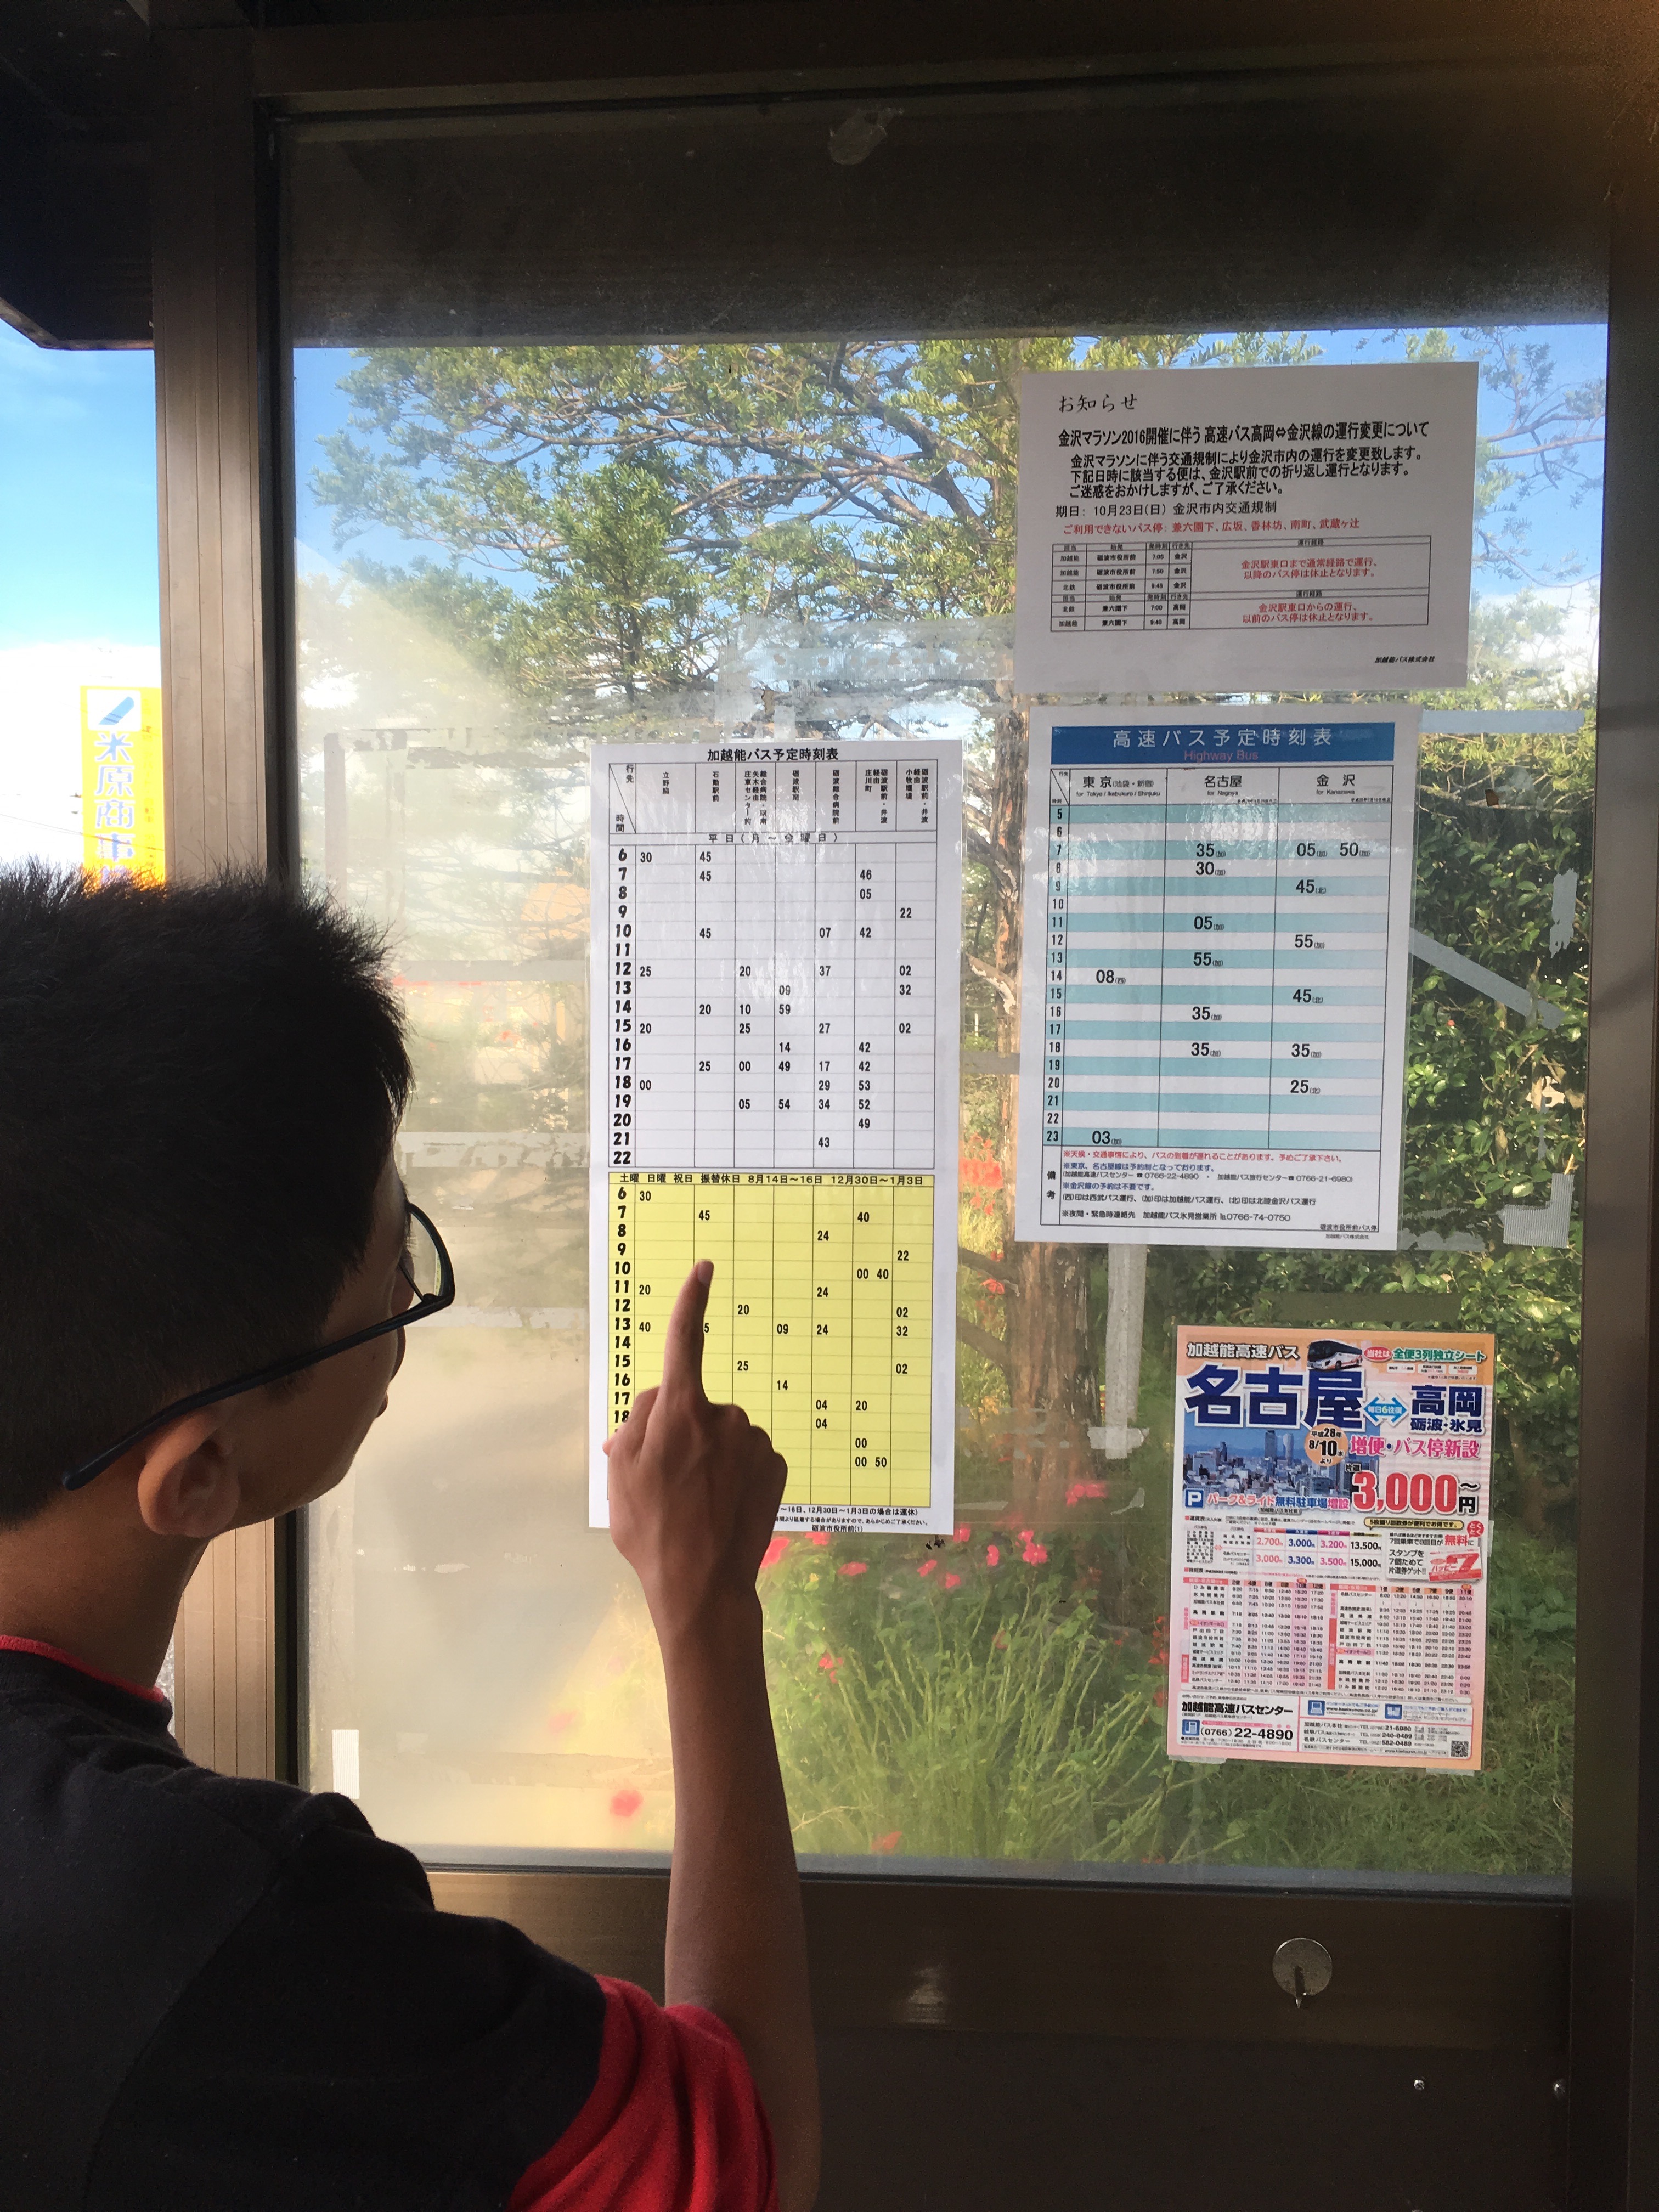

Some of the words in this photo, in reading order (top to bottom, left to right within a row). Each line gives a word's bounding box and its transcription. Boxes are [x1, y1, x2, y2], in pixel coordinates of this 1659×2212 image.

[1059, 393, 1137, 413] お知らせ
[1071, 445, 1421, 469] 金沢マラソンに伴う交通規制により金沢市内の運行を変更致します。
[1070, 461, 1409, 483] 下記日時に該当する便は、金沢駅前での折り返し運行となります。
[1070, 479, 1283, 499] ご迷惑をおかけしますが、ご了承ください。
[1172, 500, 1277, 515] 金沢市内交通規制
[1241, 557, 1377, 569] 金沢駅東口まで通常経路で運行、
[1243, 567, 1375, 579] 以降のバス停は休止となります。
[1259, 601, 1357, 613] 金沢駅東口からの運行、
[1242, 611, 1373, 623] 以前のバス停は休止となります。
[1113, 728, 1332, 748] 高速バス予定時刻表
[707, 747, 838, 762] 加越能バス予定時刻表
[1184, 750, 1233, 762] Highway
[1237, 751, 1259, 760] Bus
[625, 765, 634, 783] 行先
[1204, 775, 1242, 788] 名古屋
[616, 814, 625, 833] 時間
[618, 848, 627, 861] 6
[640, 851, 652, 863] 30
[699, 851, 712, 862] 45
[1057, 844, 1062, 856] 7
[618, 867, 627, 881] 7
[699, 870, 712, 882] 45
[860, 869, 872, 881] 46
[1056, 862, 1061, 874] 8
[1052, 952, 1063, 963] 13
[616, 962, 631, 975] 12
[640, 966, 651, 977] 25
[739, 966, 751, 977] 20
[819, 965, 831, 977] 37
[899, 965, 911, 976] 02
[1051, 970, 1062, 981] 14
[1049, 1041, 1060, 1053] 18
[616, 1057, 631, 1070] 17
[699, 1060, 711, 1071] 25
[738, 1060, 751, 1072] 00
[778, 1060, 791, 1072] 49
[819, 1060, 831, 1072] 17
[858, 1060, 871, 1072] 42
[1047, 1130, 1058, 1142] 23
[620, 1172, 640, 1183] 土曜
[647, 1173, 667, 1183] 日曜
[673, 1173, 692, 1183] 祝日
[701, 1173, 740, 1184] 振替休日
[1047, 1170, 1056, 1200] 備考
[1063, 1182, 1154, 1191] ※金沢線の予約は不要です。
[617, 1205, 627, 1218] 7
[698, 1210, 710, 1221] 45
[857, 1211, 870, 1223] 40
[615, 1261, 631, 1275] 10
[856, 1268, 869, 1279] 00
[877, 1268, 889, 1280] 40
[615, 1317, 631, 1330] 13
[639, 1322, 651, 1333] 40
[776, 1323, 789, 1335] 09
[816, 1324, 828, 1335] 24
[896, 1325, 908, 1337] 32
[1187, 1342, 1300, 1359] 加越能高速バス
[1393, 1348, 1486, 1361] 全便3列独立シート
[1186, 1364, 1364, 1426] 名古屋
[1412, 1385, 1482, 1417] 高岡
[1368, 1406, 1402, 1414] 毎日6往復
[1410, 1418, 1482, 1432] 砺波・氷見
[1311, 1428, 1342, 1438] 平成28年
[1309, 1440, 1338, 1456] 8/10
[1350, 1435, 1479, 1458] 増便・バス停新設
[1345, 1463, 1362, 1472] 片道
[1353, 1470, 1458, 1512] 3,000
[1207, 1493, 1350, 1509] パーク&ライド無料駐車場増設
[1182, 1701, 1293, 1715] 加越能高速バスセンター
[1234, 1728, 1293, 1740] 22-4890
